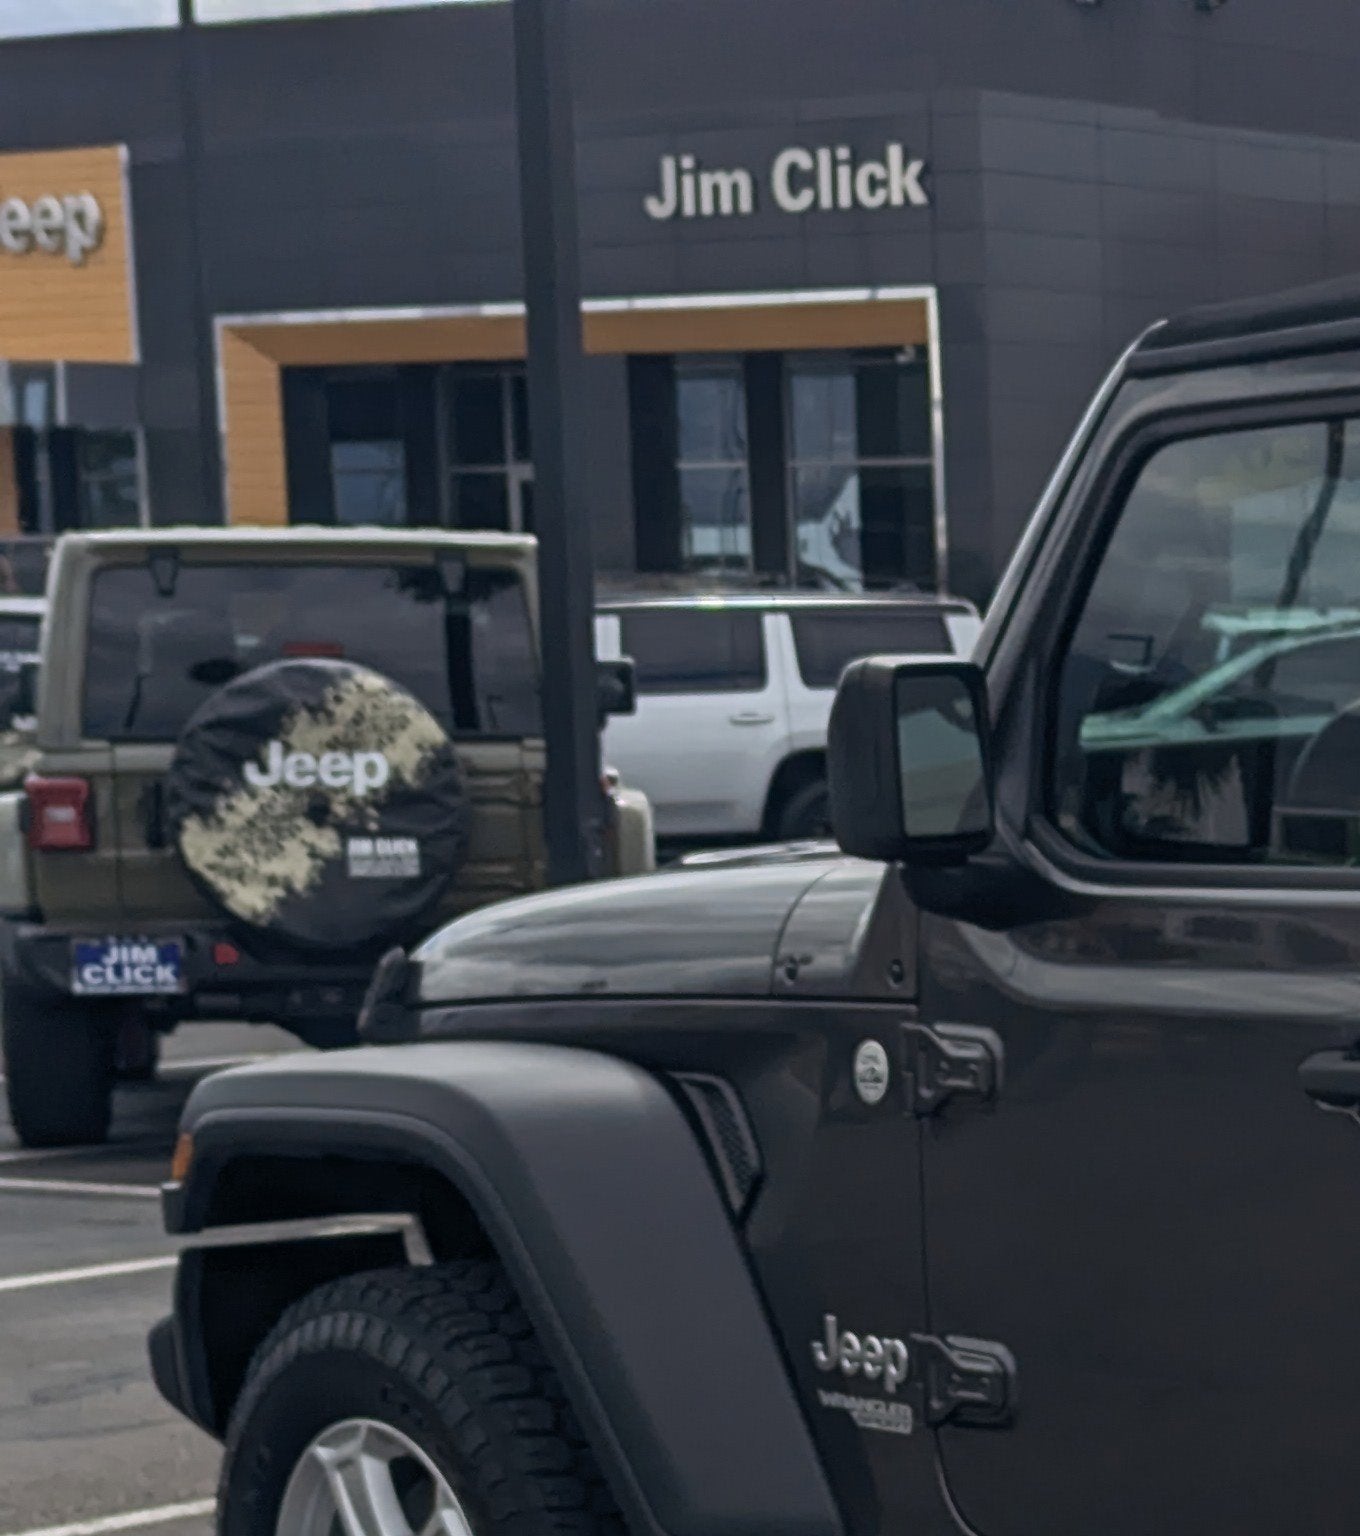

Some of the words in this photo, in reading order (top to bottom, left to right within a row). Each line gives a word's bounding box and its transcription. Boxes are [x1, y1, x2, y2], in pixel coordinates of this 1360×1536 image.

[645, 153, 752, 219] Jim
[772, 143, 929, 212] Click
[0, 194, 101, 263] eep
[243, 740, 389, 796] Jeep
[82, 964, 178, 985] CLICK
[103, 946, 158, 965] JIM
[812, 1313, 908, 1394] Jeep
